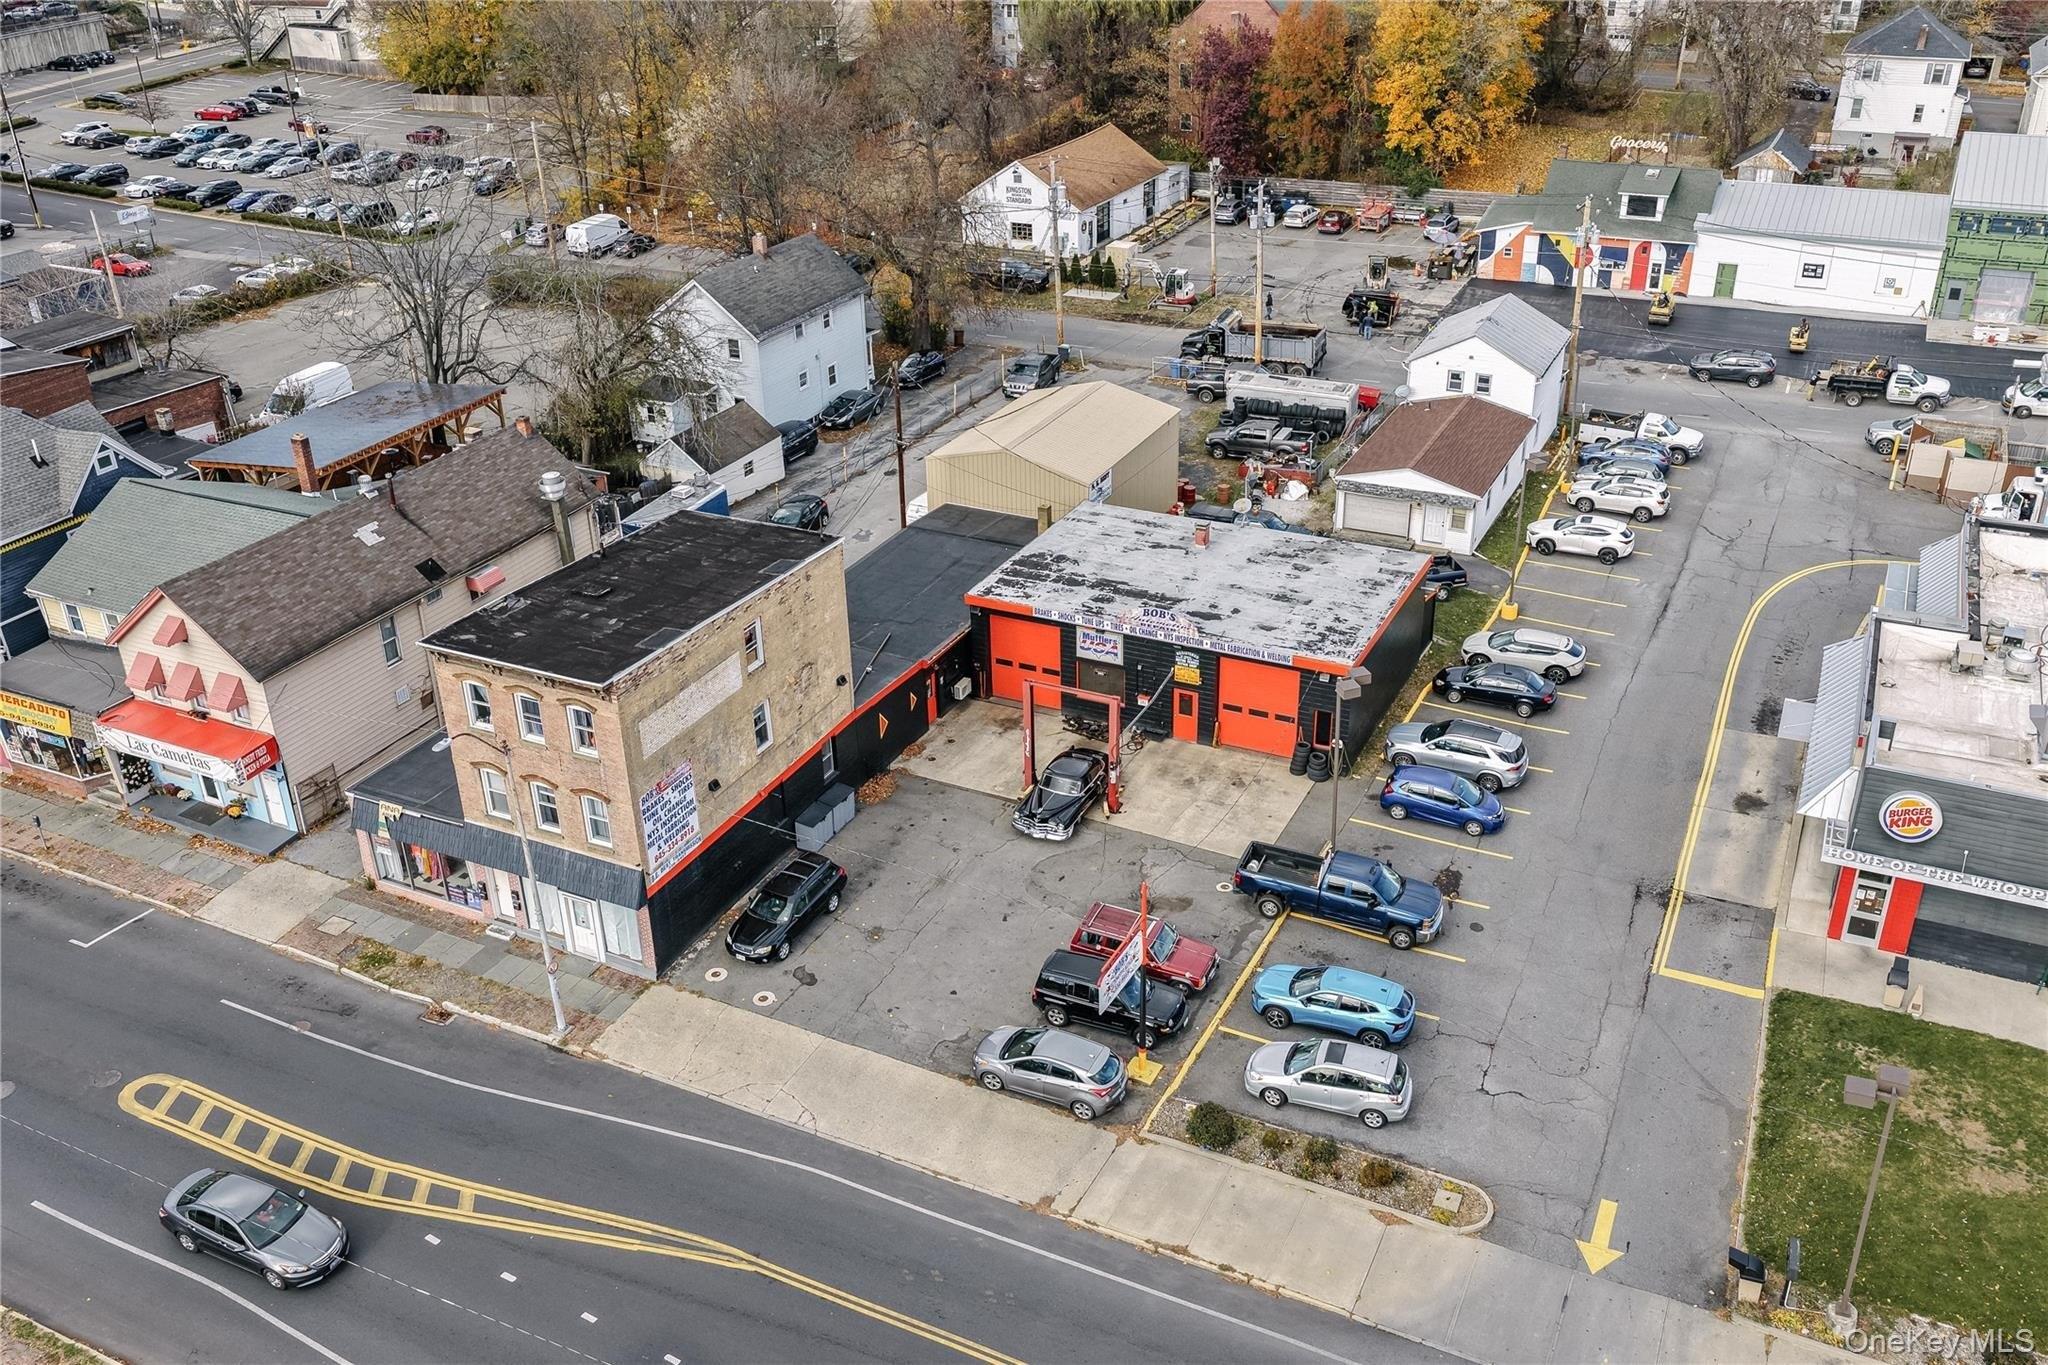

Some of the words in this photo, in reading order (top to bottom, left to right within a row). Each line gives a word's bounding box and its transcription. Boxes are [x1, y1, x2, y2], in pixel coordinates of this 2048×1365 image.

[1610, 135, 1667, 153] Grocery
[1006, 186, 1032, 196] KINGSTON
[1006, 196, 1032, 204] STANDARD
[1142, 608, 1176, 621] BOB'S
[1034, 607, 1053, 618] BRAKES
[1057, 611, 1076, 622] SHOCKS
[1081, 616, 1095, 626] TUNE
[1095, 618, 1105, 628] UPS
[1111, 622, 1124, 631] TIRES
[1129, 626, 1138, 634] OIL
[1138, 627, 1158, 638] CHANGE
[1163, 632, 1174, 641] NYS
[1174, 634, 1204, 647] INSPECTION
[1210, 641, 1226, 651] METAL
[1227, 644, 1261, 658] FABRICATION
[1266, 653, 1291, 663] WELDING
[126, 735, 151, 754] Las
[151, 742, 212, 772] Camelias
[642, 793, 665, 816] BRAKES
[671, 772, 692, 794] SHOCKS
[643, 807, 659, 824] TUNE
[660, 798, 672, 812] UPS
[678, 780, 693, 797] TIRES
[652, 814, 663, 826] OIL
[664, 794, 687, 817] CHANGE
[647, 825, 660, 841] NYS
[660, 797, 695, 830] INSPECTION
[647, 832, 664, 850] METAL
[665, 804, 697, 836] FABRICATION
[1888, 807, 1933, 818] BURGER
[1888, 815, 1934, 829] KING
[663, 819, 690, 846] WELDING
[1828, 847, 1884, 868] HOME
[1890, 860, 1918, 874] OF
[1923, 865, 1965, 884] THE
[1971, 876, 2048, 903] WHOPP
